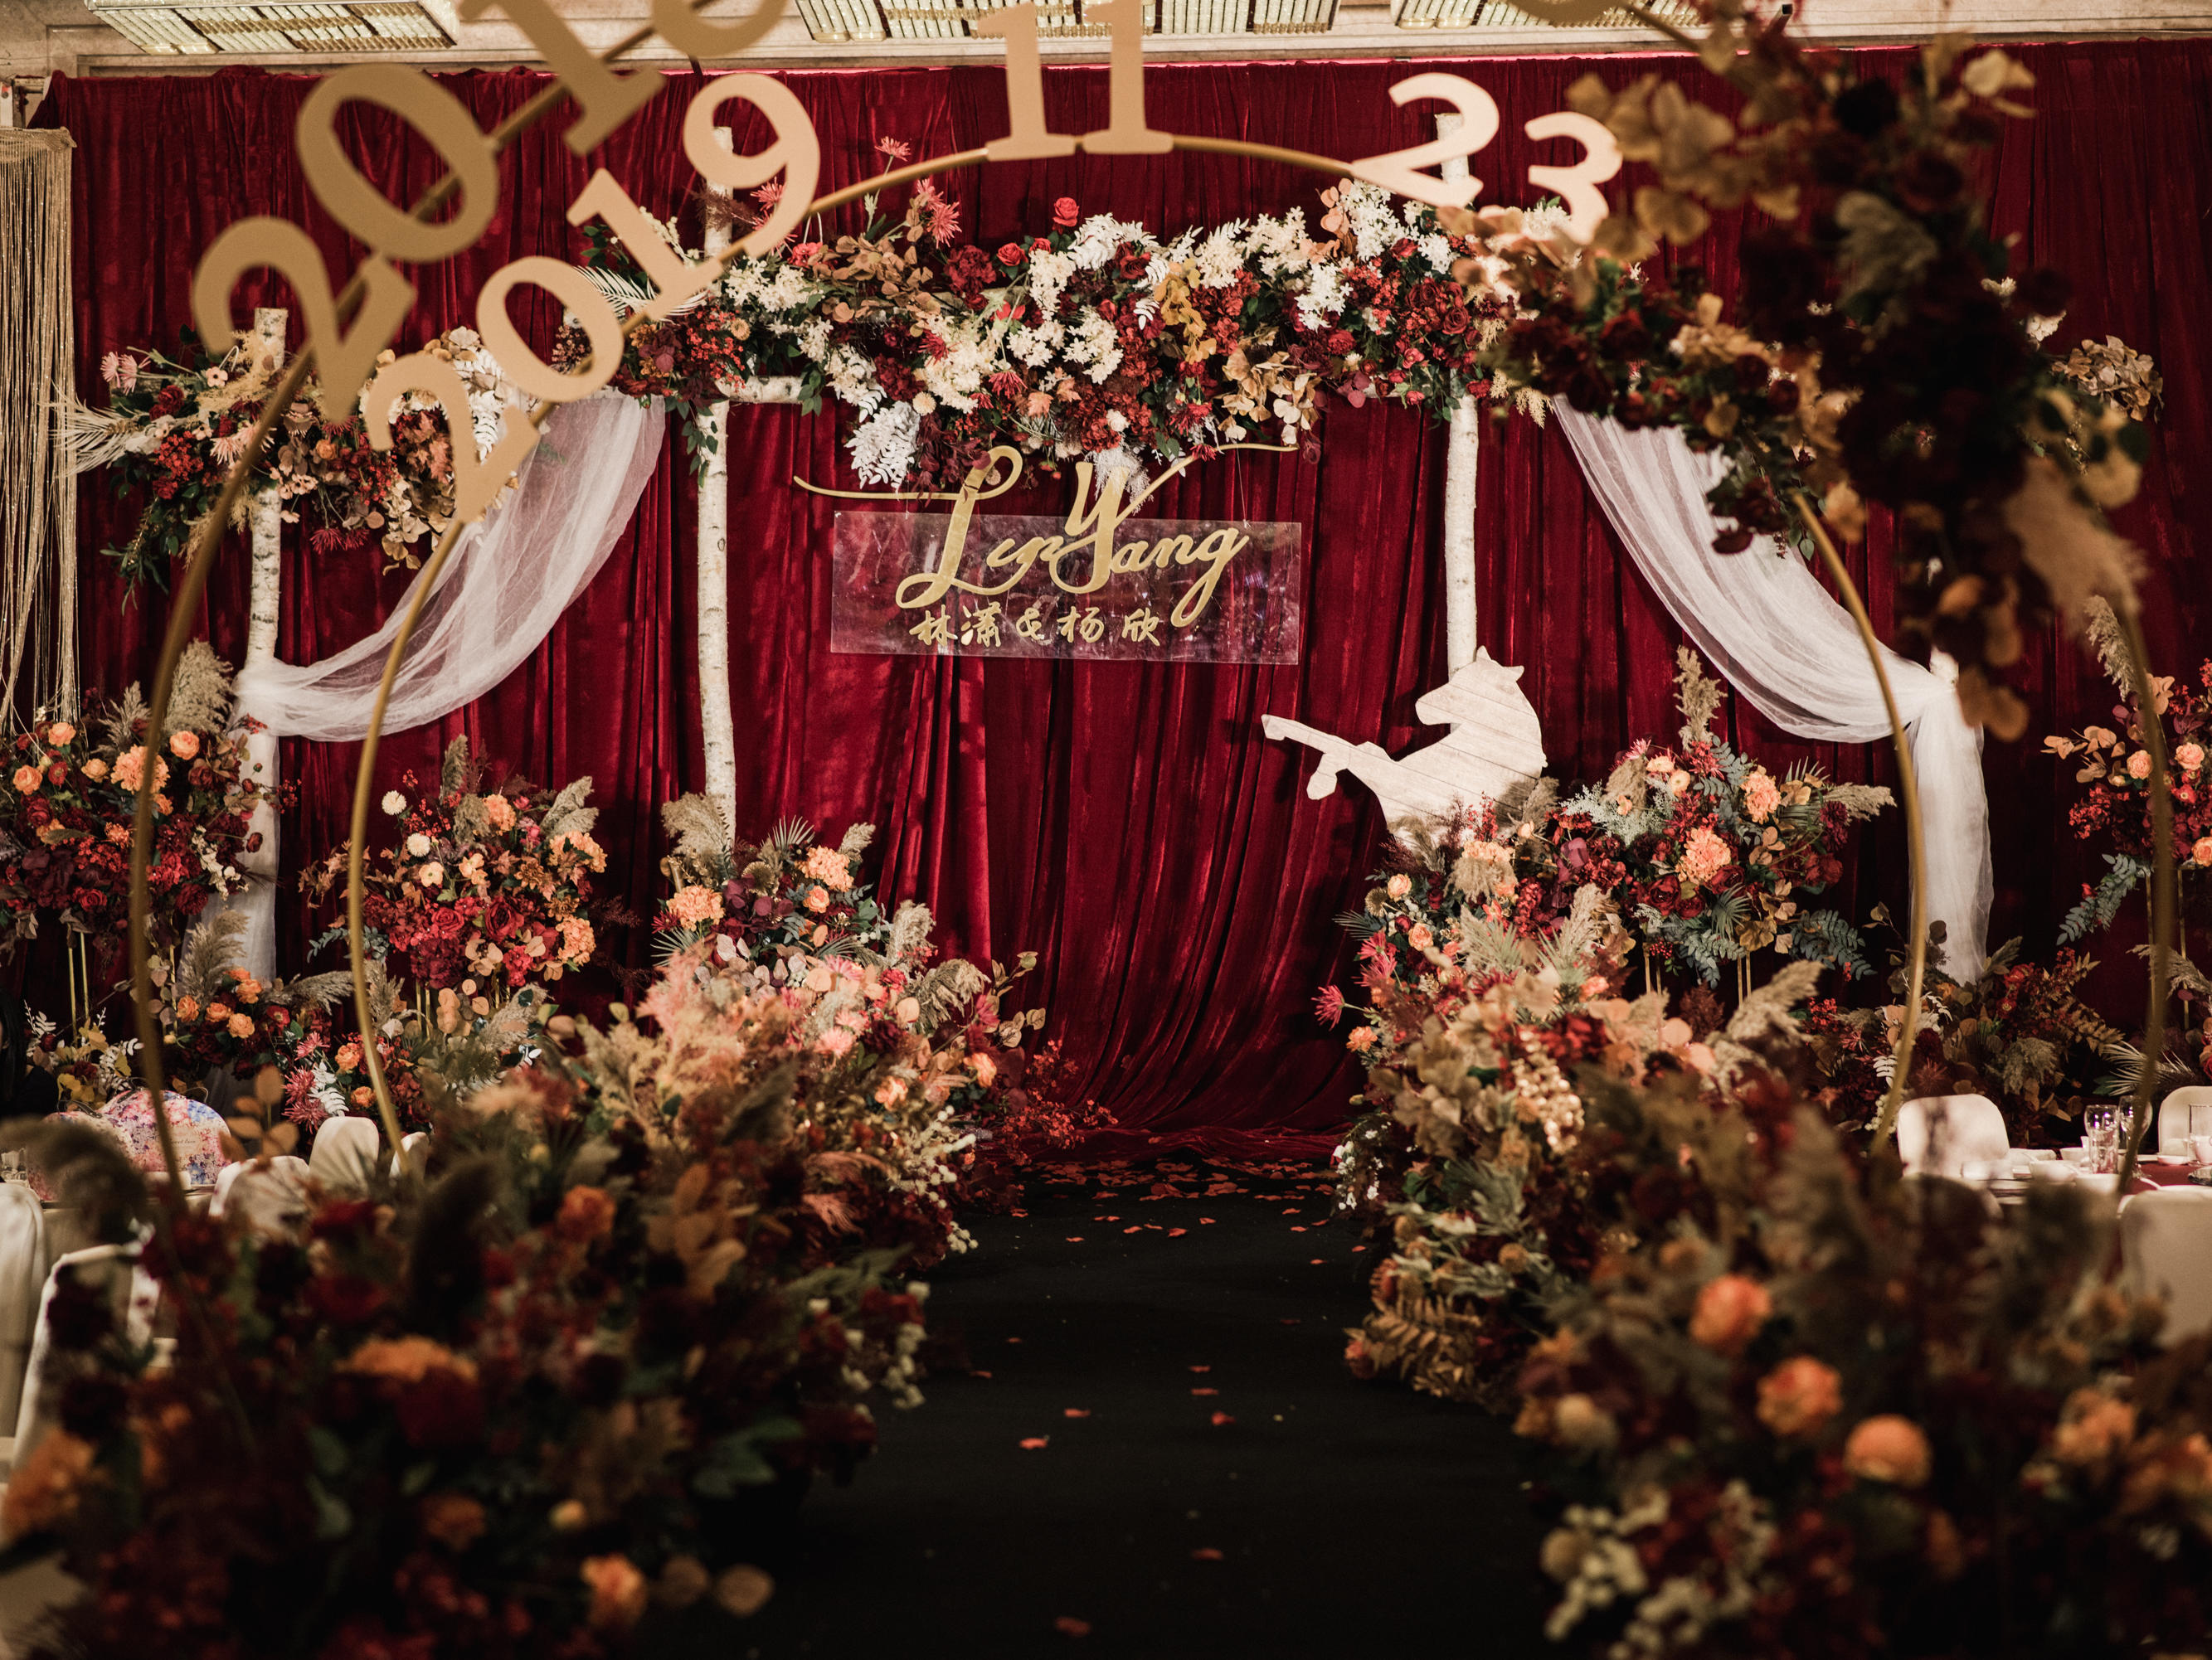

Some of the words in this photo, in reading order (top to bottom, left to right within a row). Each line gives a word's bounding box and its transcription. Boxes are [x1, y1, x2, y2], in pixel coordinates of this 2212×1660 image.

[365, 72, 820, 523] 2019
[977, 0, 1173, 161] 11
[1350, 72, 1623, 245] 23
